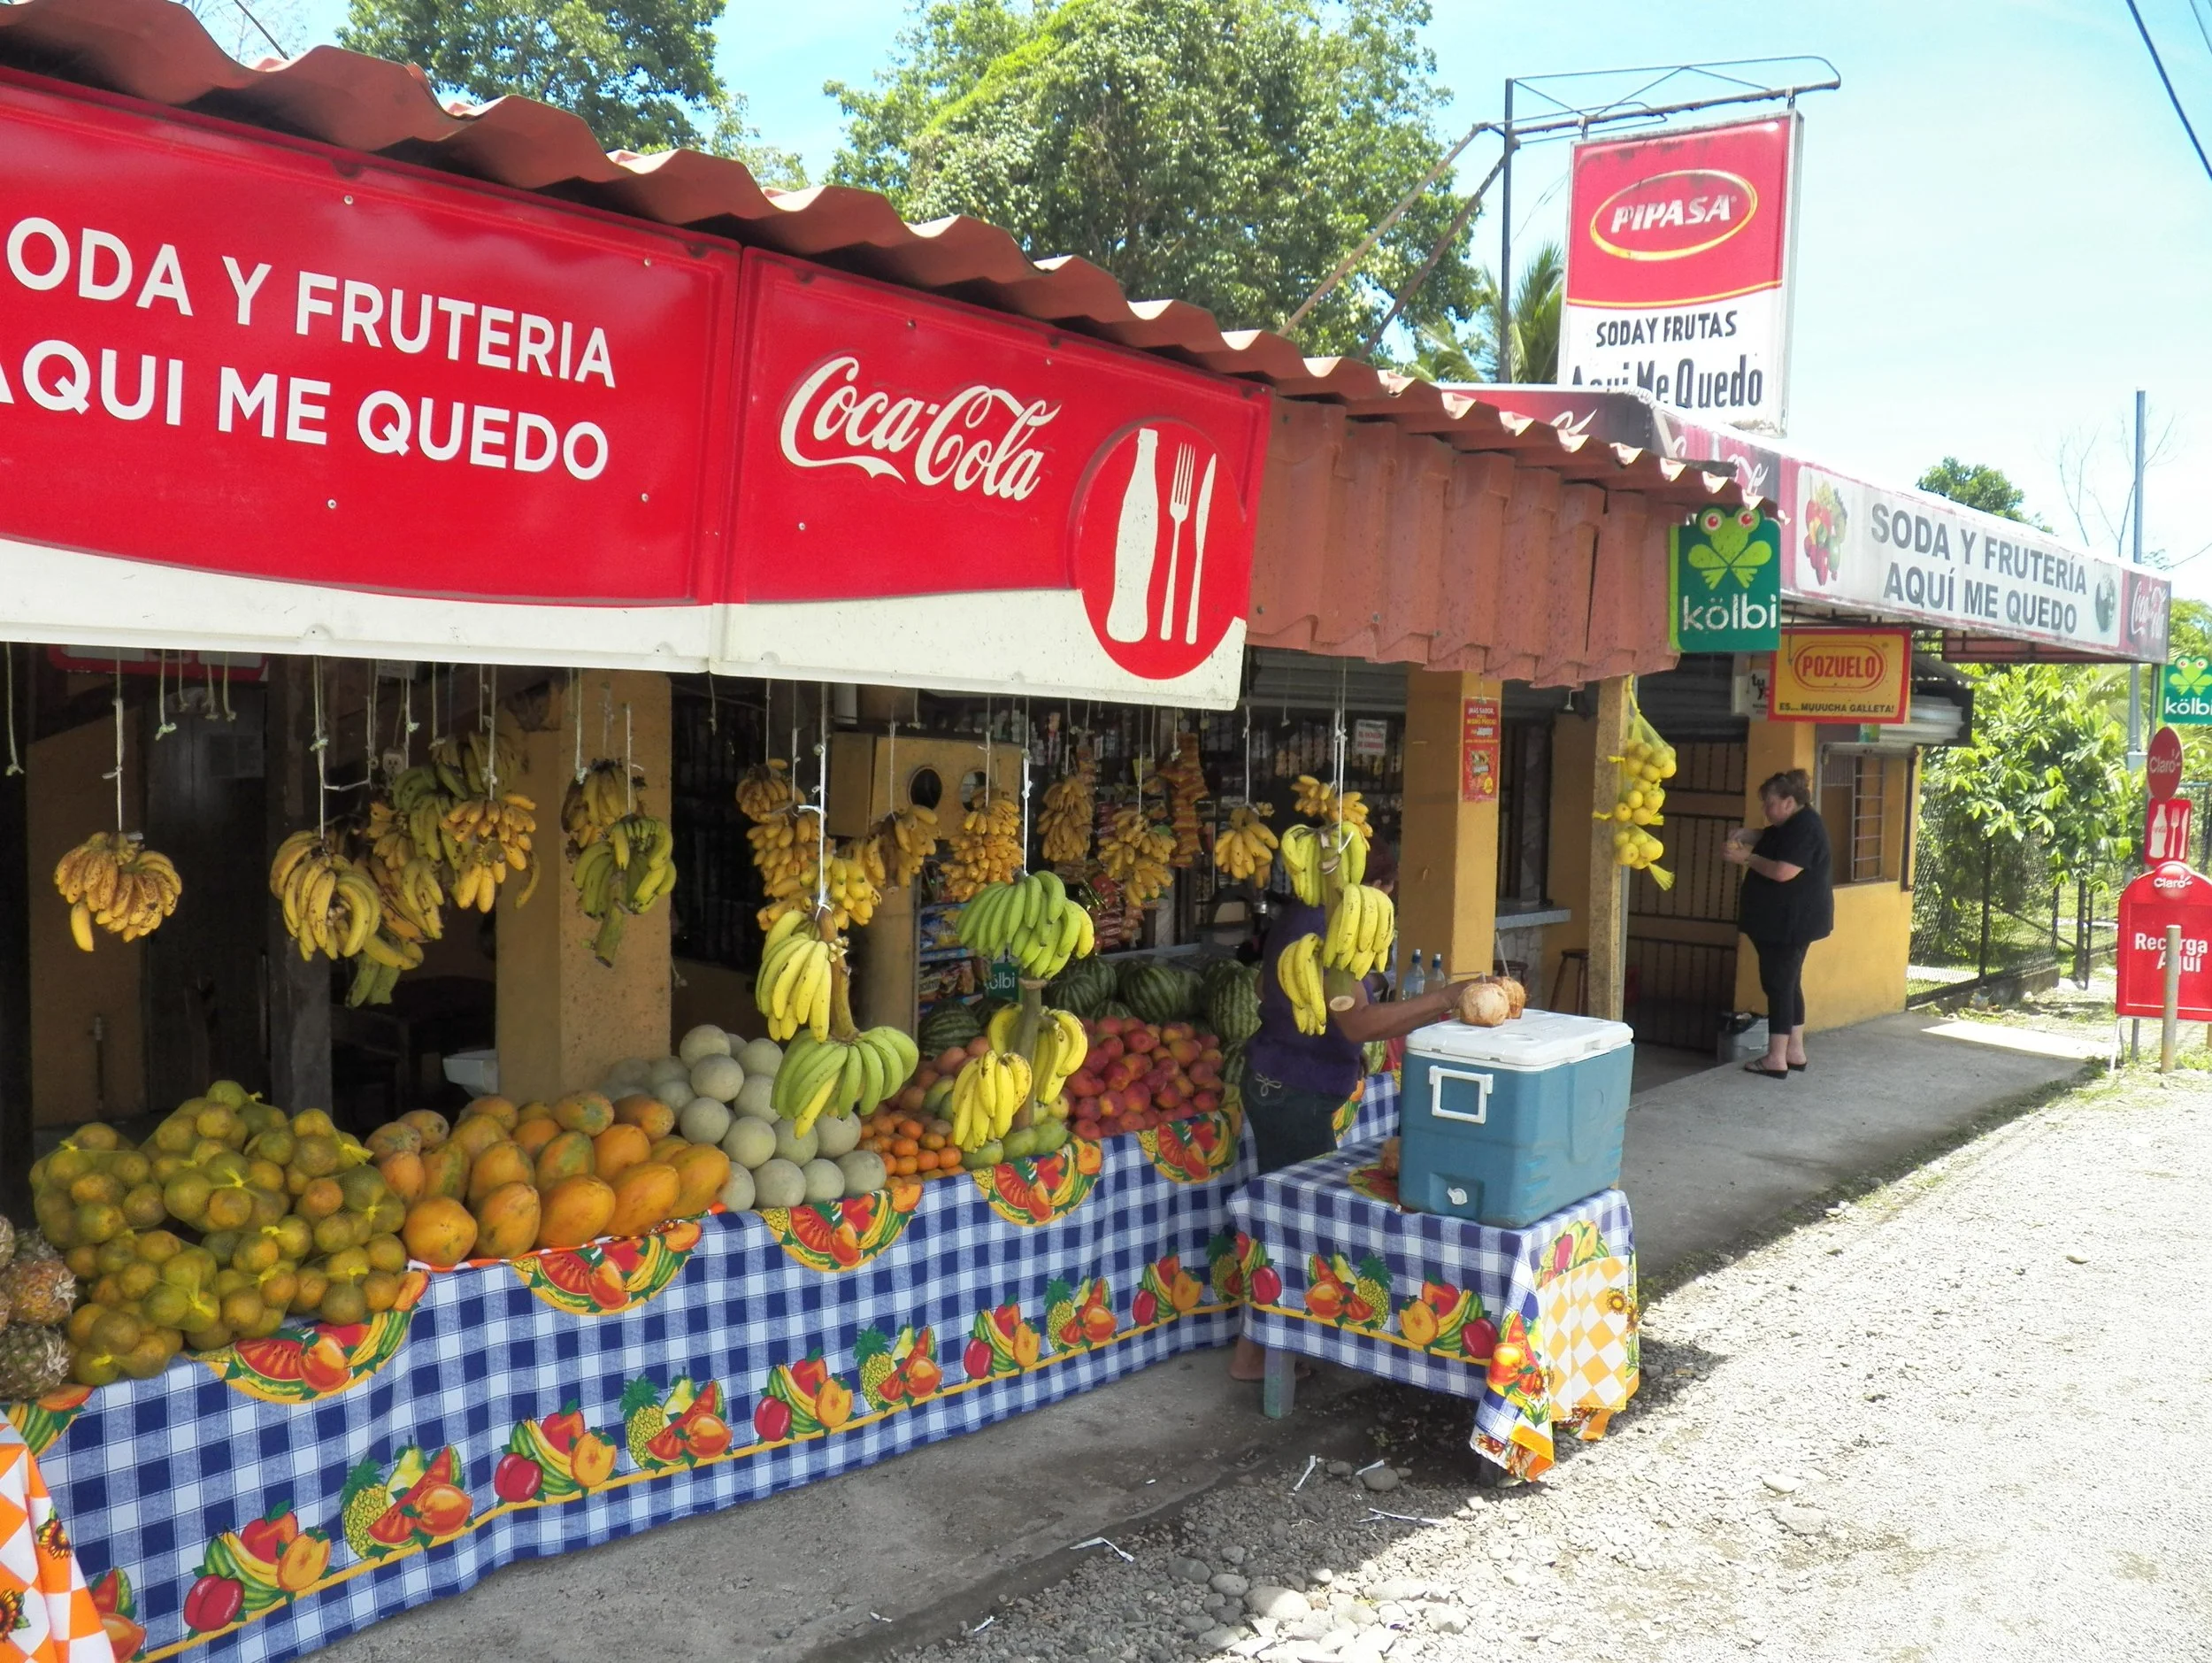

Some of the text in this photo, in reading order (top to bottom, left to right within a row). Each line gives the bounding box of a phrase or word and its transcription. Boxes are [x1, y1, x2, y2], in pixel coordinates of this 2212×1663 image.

[1610, 194, 1731, 234] PIPASA
[222, 256, 272, 326] Y
[296, 270, 616, 389] FRUTERIA
[1663, 310, 1738, 343] FRUTAS
[1675, 354, 1763, 410] Quedo
[0, 339, 610, 481] QUI ME QUEDO
[780, 356, 1061, 501] Coca-Cola
[1871, 503, 2087, 596] SODA Y FRUTERÍA
[1683, 593, 1777, 631] kölbi
[1883, 561, 2078, 635] AQUÍ ME QUEDO
[1801, 655, 1876, 678] POZUELO
[2148, 754, 2177, 774] Claro
[2153, 876, 2186, 889] Claro
[2135, 932, 2208, 955] Recrga
